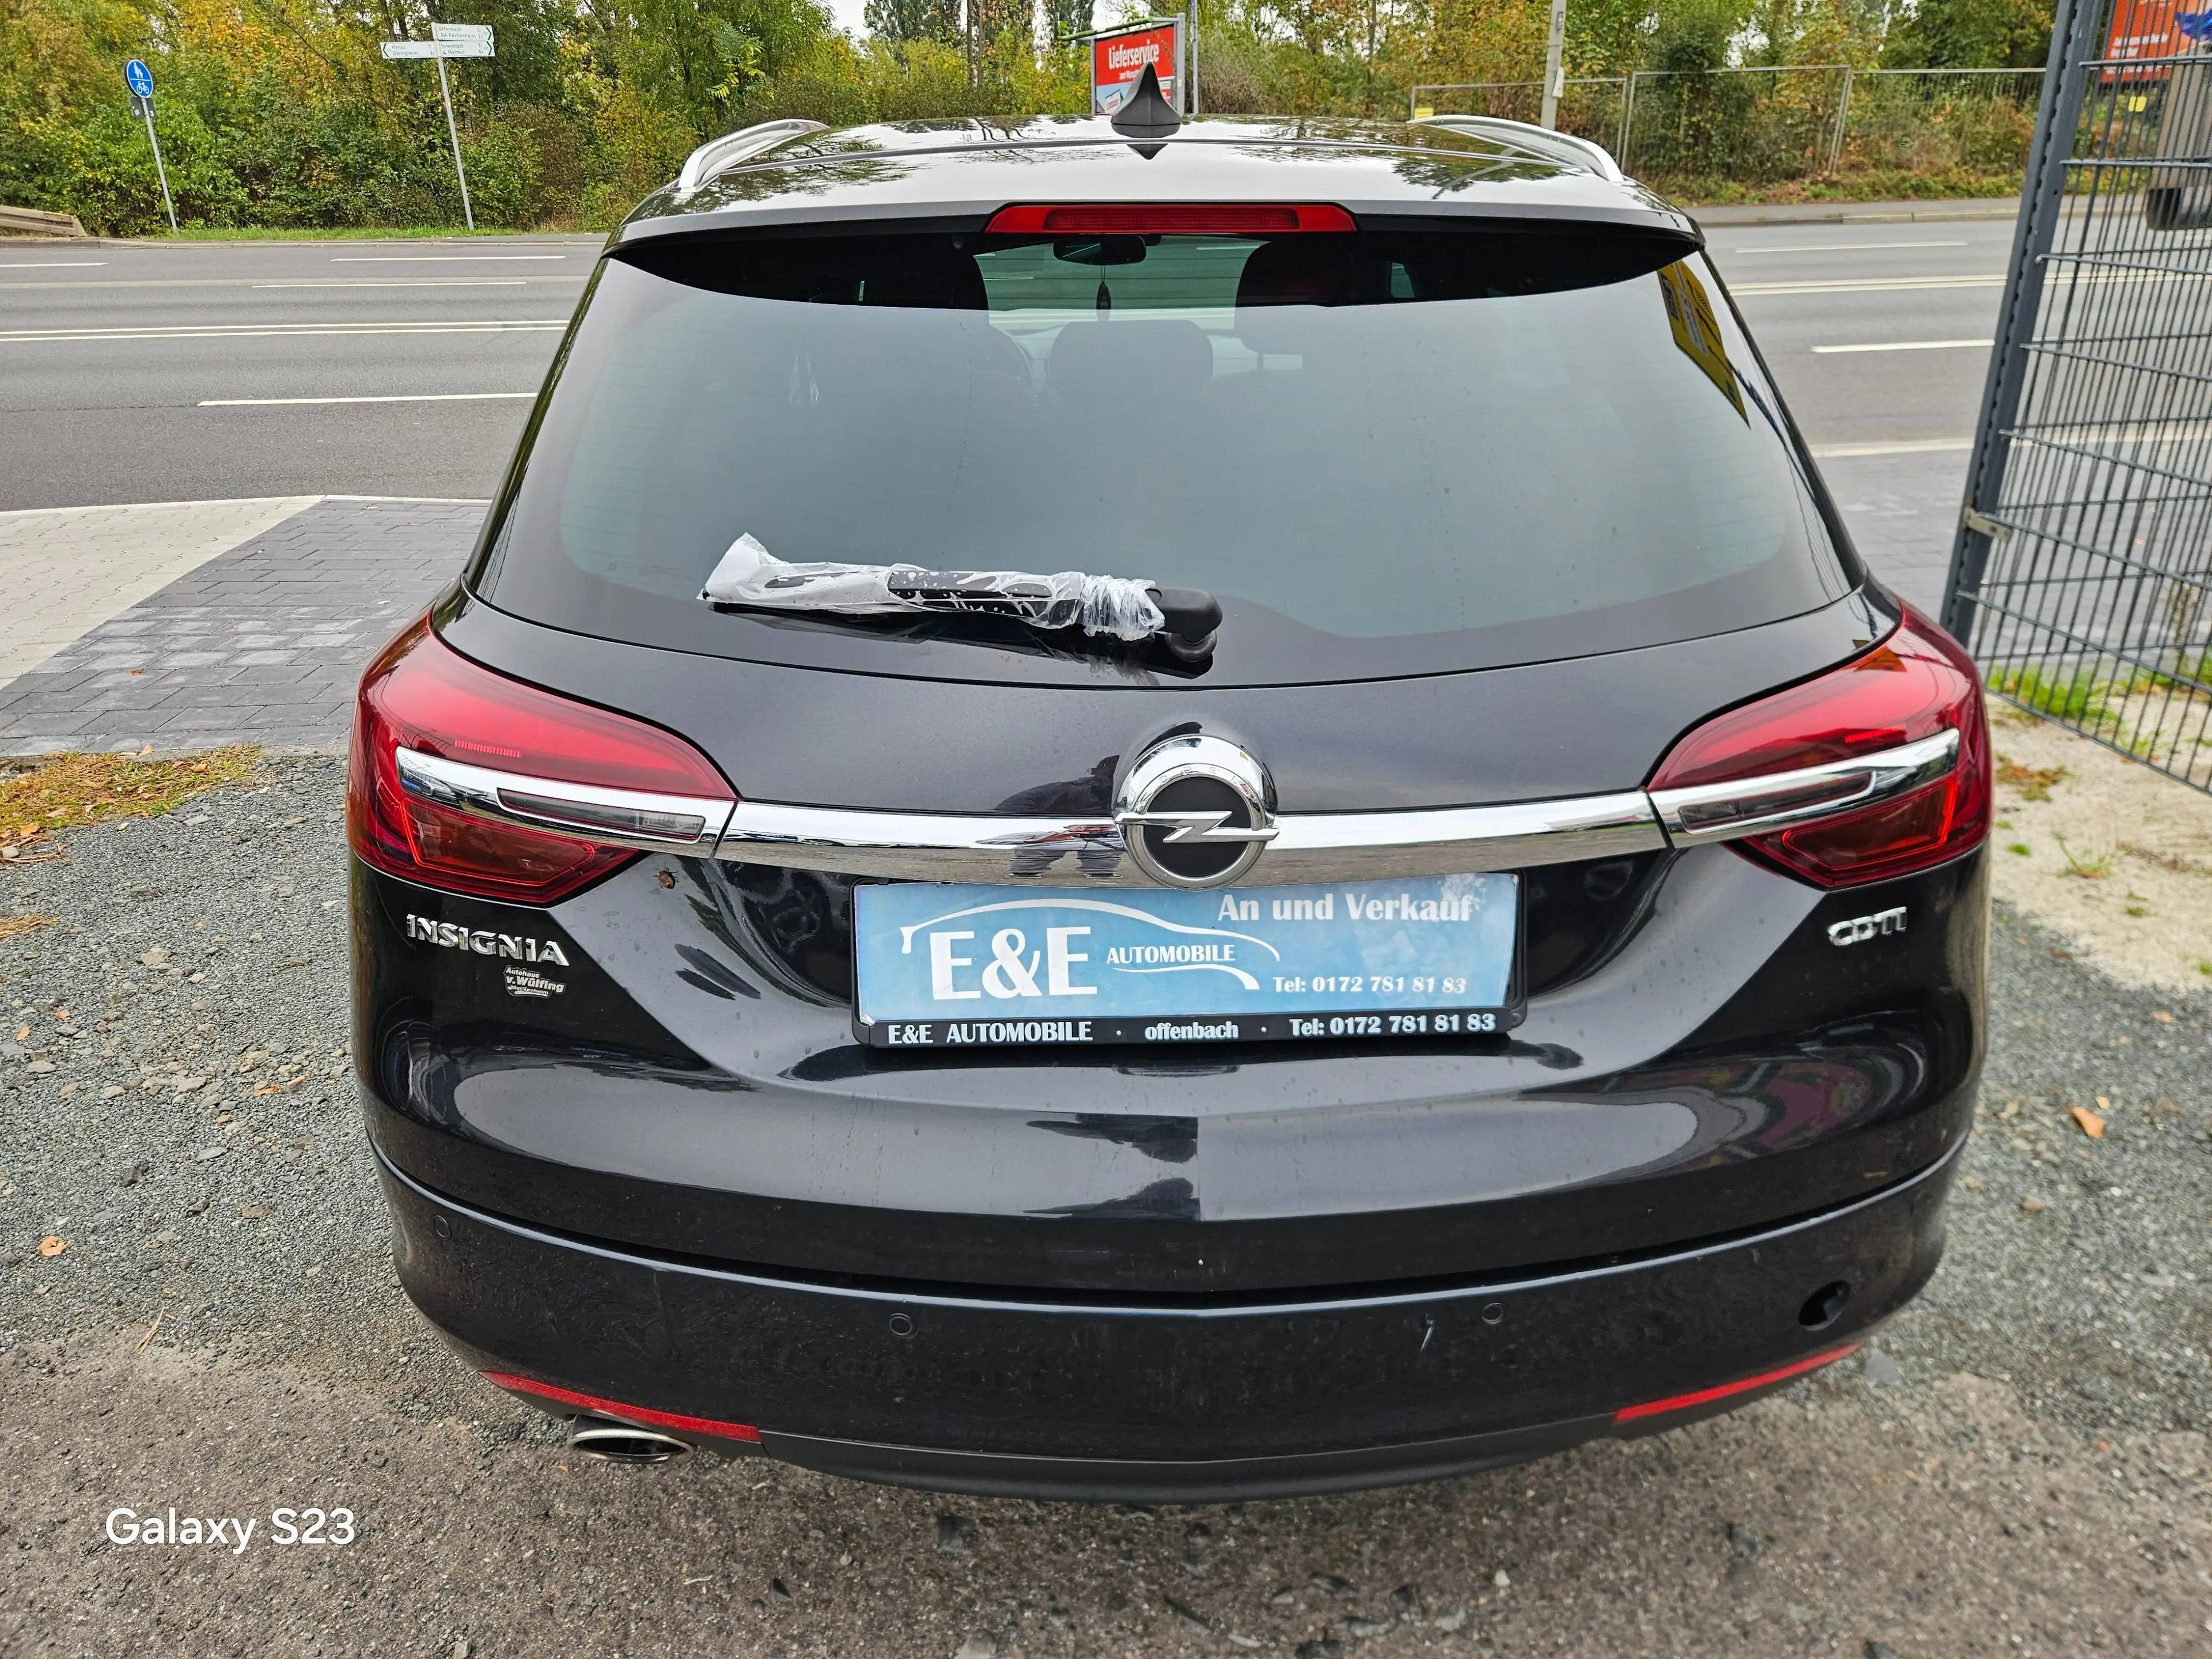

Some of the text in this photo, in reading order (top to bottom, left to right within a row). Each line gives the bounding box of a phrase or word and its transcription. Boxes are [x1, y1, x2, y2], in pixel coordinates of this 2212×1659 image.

[1108, 39, 1160, 70] Lieferservice
[1159, 766, 1240, 785] OPEL
[1218, 892, 1473, 922] An und Verkauf
[406, 914, 570, 967] INSIGNIA
[1107, 945, 1236, 964] AUTOMOBILE
[506, 967, 540, 978] Autohaus
[930, 926, 1097, 1000] E&E
[1273, 976, 1467, 994] Tel: 0172 781 81 83
[888, 1013, 1497, 1044] E&E AUTOMOBILE offenbach Tel: 0172 781 81 83
